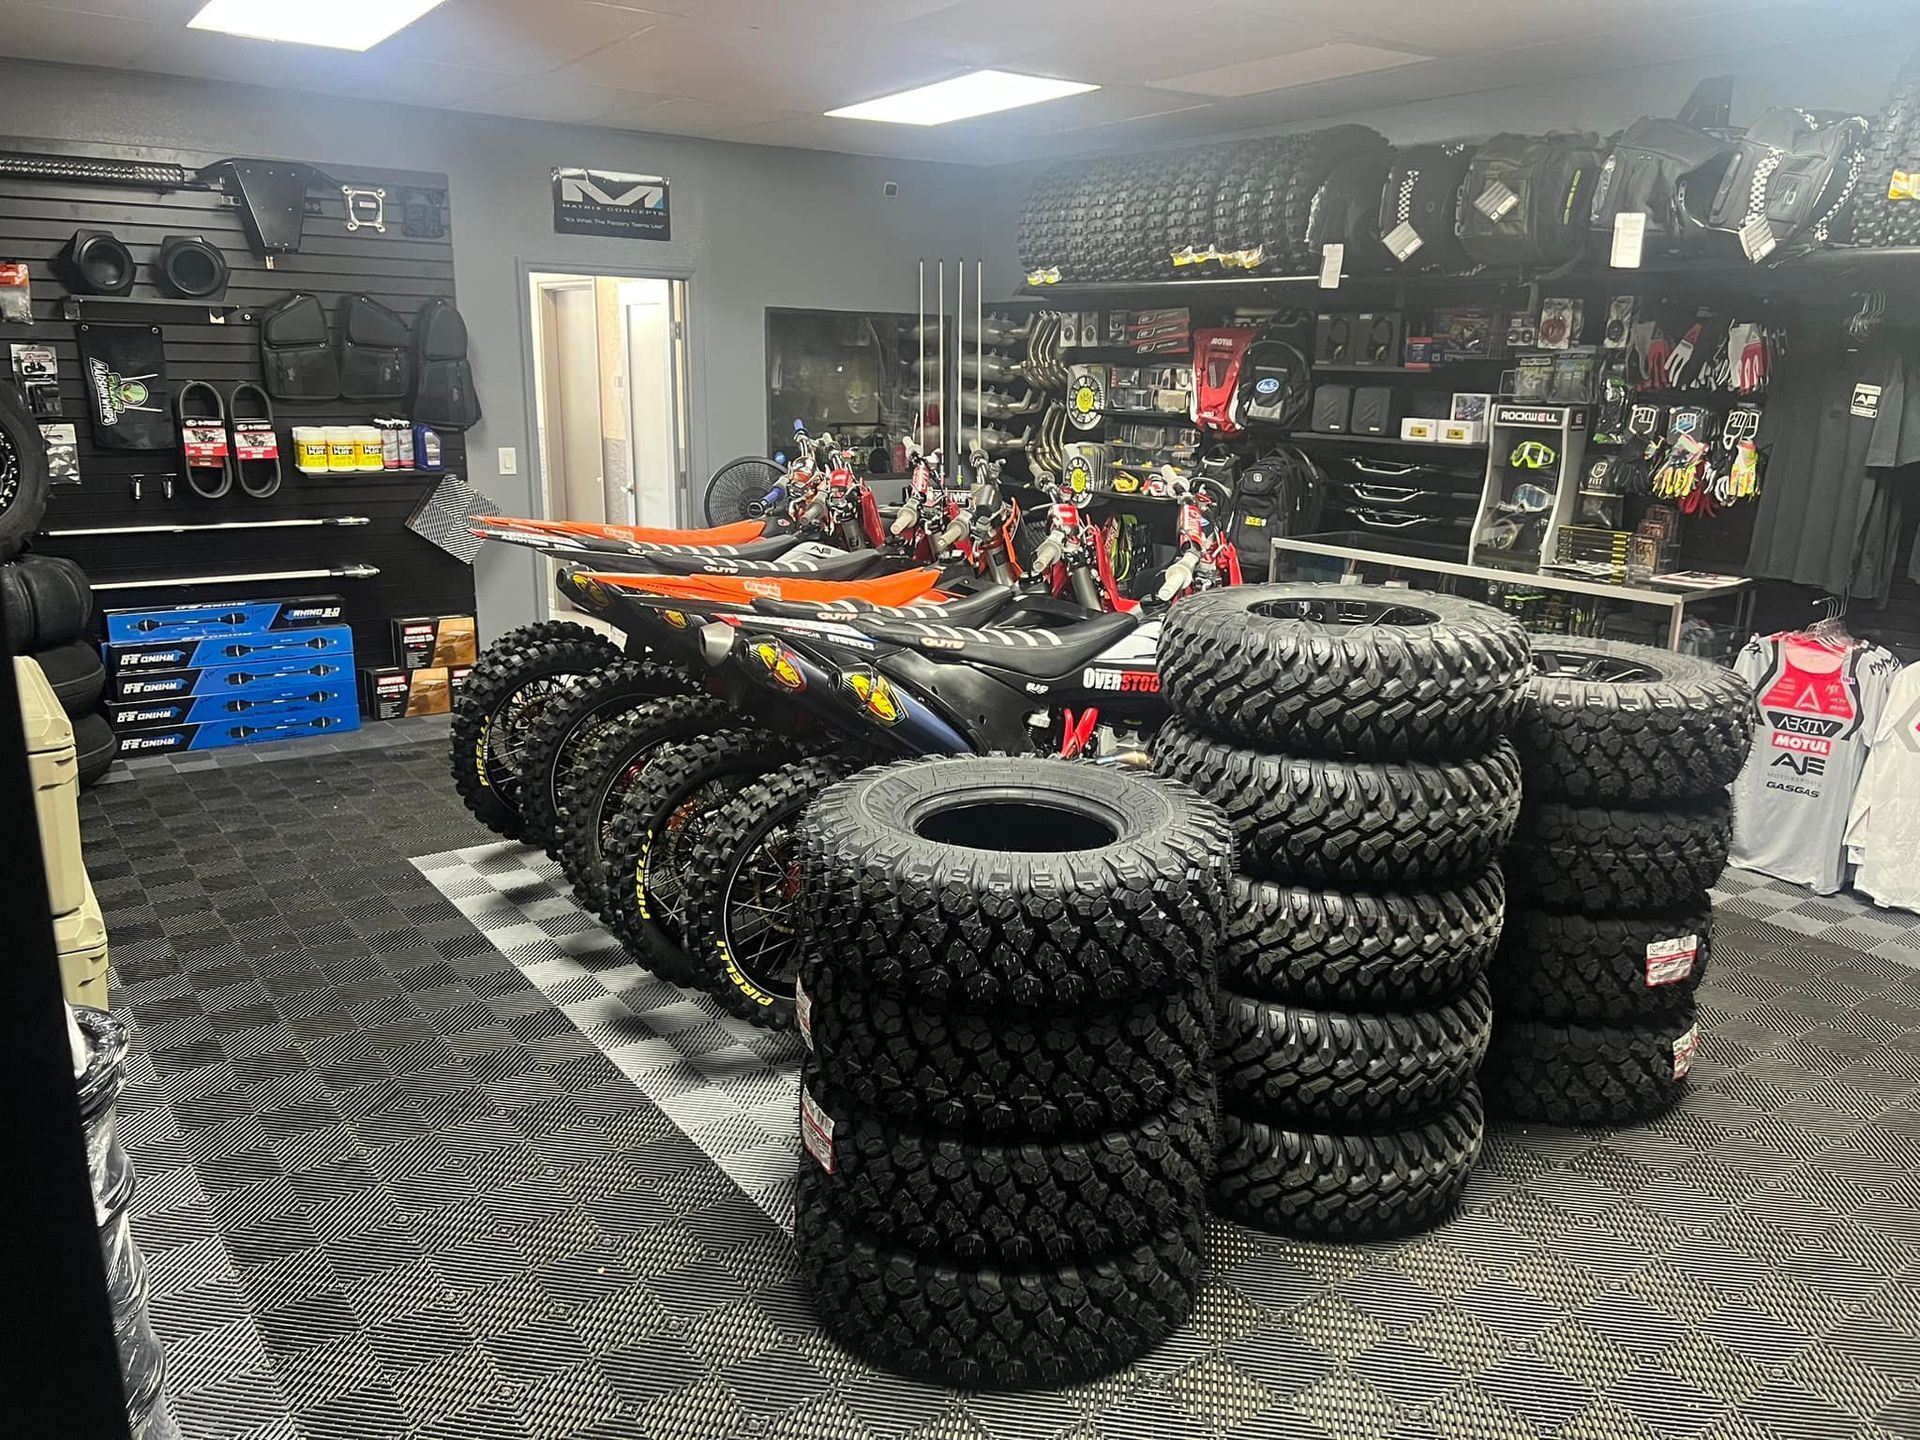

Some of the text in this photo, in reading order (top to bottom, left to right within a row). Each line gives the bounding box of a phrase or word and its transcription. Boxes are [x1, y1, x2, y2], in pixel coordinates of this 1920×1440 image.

[562, 203, 666, 216] MATRIX CONCEPTS
[1501, 411, 1558, 423] ROCKWELL
[1588, 477, 1603, 485] FIST
[293, 608, 323, 617] RHINO
[140, 653, 174, 663] RHINO
[1083, 667, 1161, 693] OVERSTOC
[143, 682, 177, 692] RHINO
[137, 710, 171, 720] RHINO
[141, 737, 175, 748] RHINO
[1774, 734, 1829, 753] MOTUL
[475, 714, 493, 787] PIRELLI
[1766, 781, 1820, 798] GASGAS
[634, 828, 654, 920] PIRELLI
[716, 940, 774, 1007] PIRELLI
